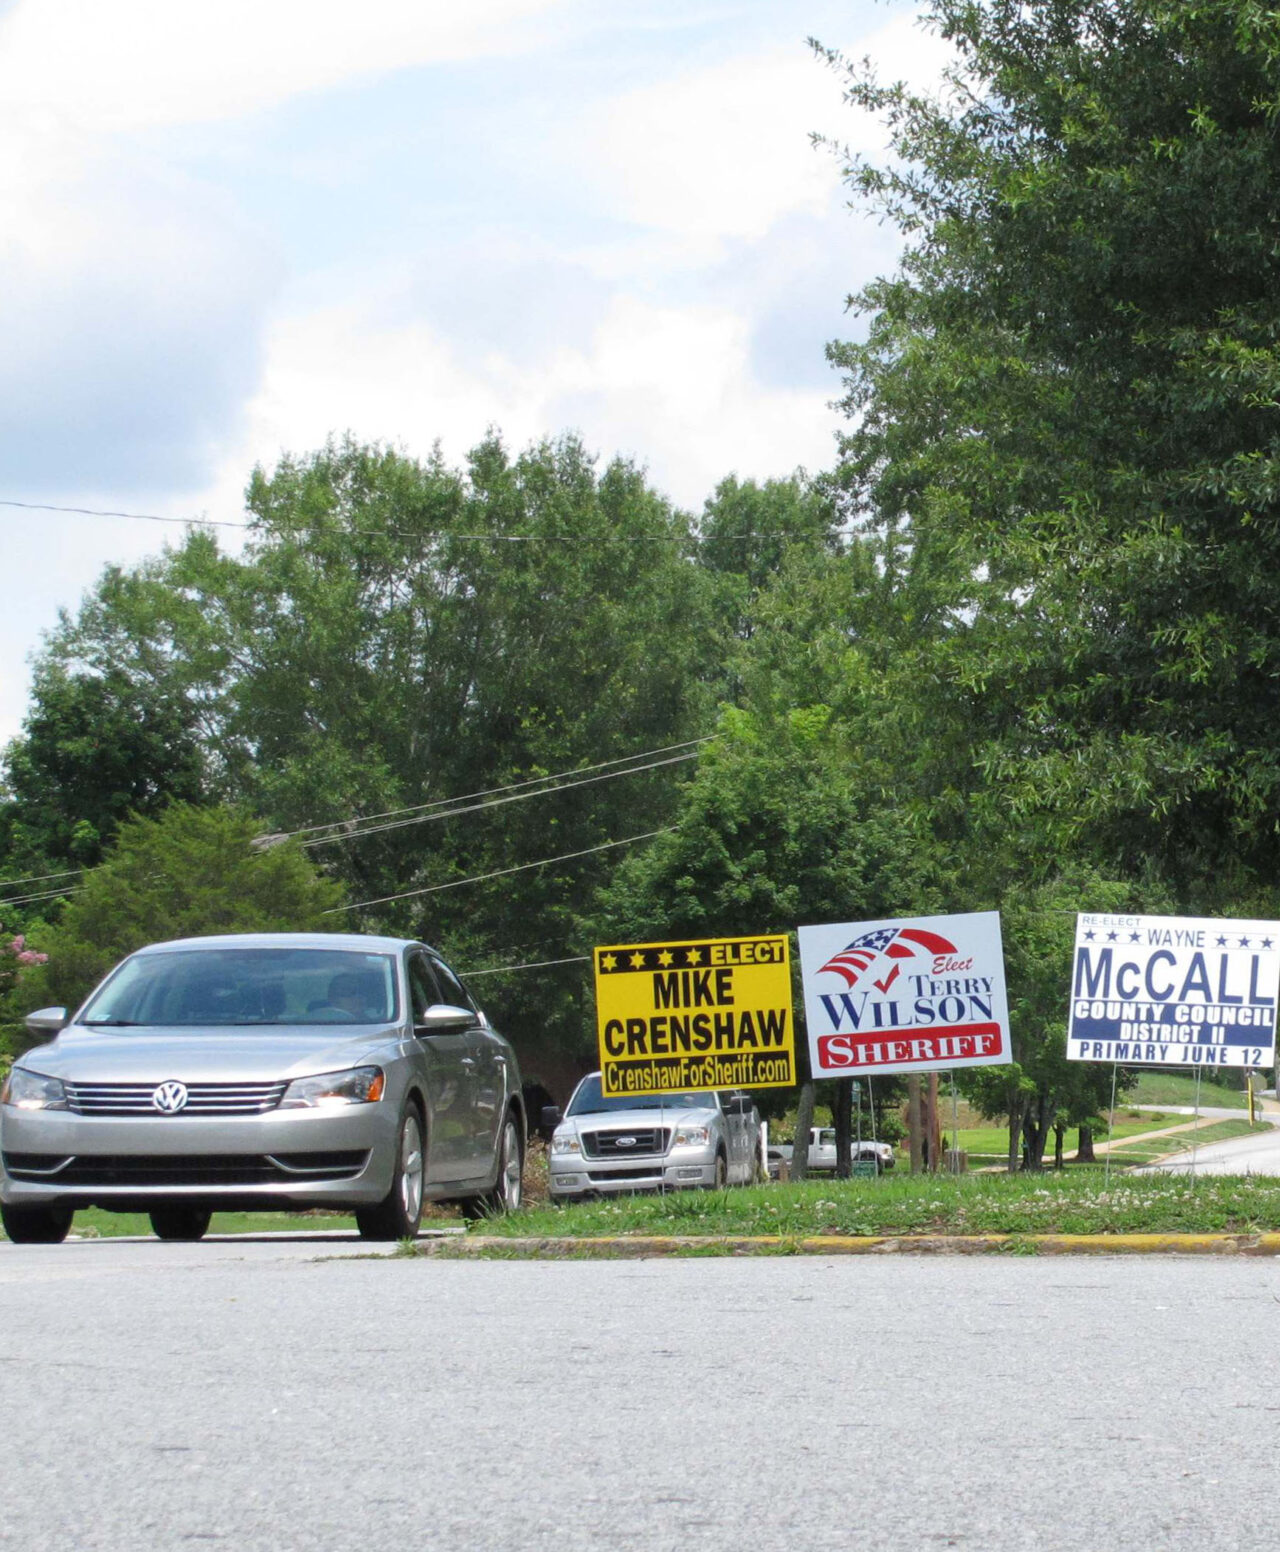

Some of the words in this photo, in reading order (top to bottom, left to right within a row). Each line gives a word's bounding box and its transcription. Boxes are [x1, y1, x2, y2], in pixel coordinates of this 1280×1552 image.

[1082, 916, 1142, 927] RE-ELECT
[1147, 928, 1206, 948] WAYNE
[710, 941, 784, 965] ELECT
[932, 955, 974, 976] Elect
[1074, 946, 1275, 1006] McCALL
[653, 968, 735, 1009] MIKE
[908, 974, 995, 998] TERRY
[817, 991, 993, 1031] WILSON
[1075, 1001, 1165, 1022] COUNTY
[1174, 1004, 1273, 1026] COUNCIL
[604, 1009, 786, 1057] CRENSHAW
[1120, 1023, 1201, 1043] DISTRICT
[1211, 1026, 1225, 1044] II
[826, 1033, 995, 1066] SHERIFF
[1079, 1041, 1169, 1061] PRIMARY
[1182, 1045, 1228, 1064] JUNE
[1241, 1048, 1262, 1065] 12
[607, 1055, 789, 1091] CrenshawForSheriff.com
